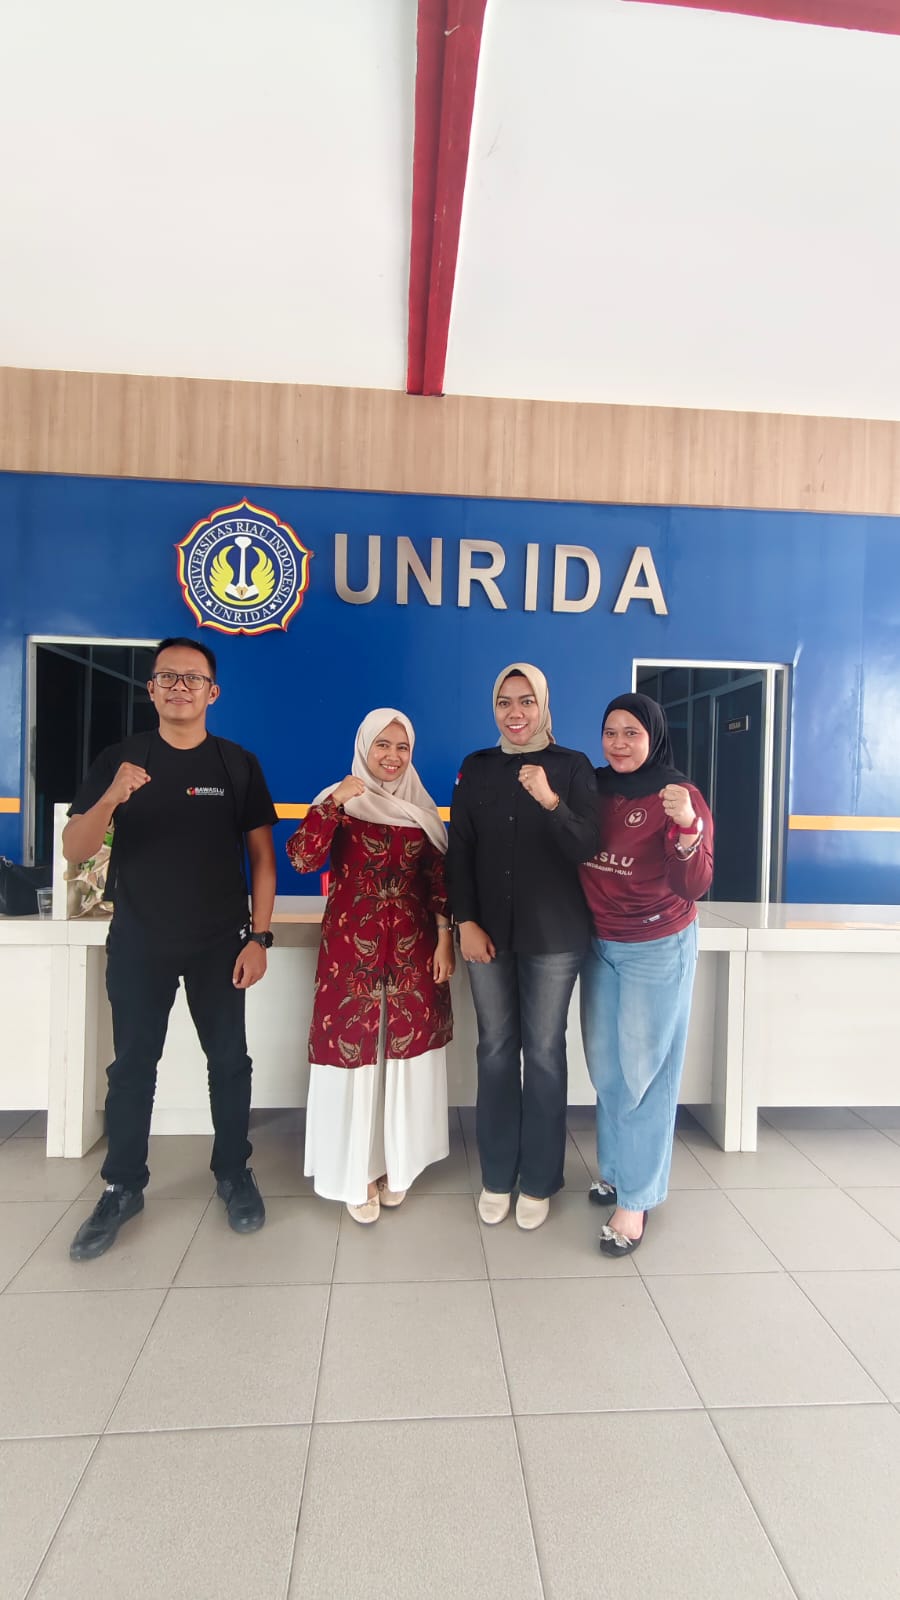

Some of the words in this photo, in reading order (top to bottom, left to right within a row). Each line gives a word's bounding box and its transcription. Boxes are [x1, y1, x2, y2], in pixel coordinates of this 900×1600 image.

[191, 524, 233, 600] UNIVERSITAS
[236, 522, 270, 538] RIAU
[268, 535, 294, 609] INDONESIA
[335, 533, 668, 615] UNRIDA
[212, 604, 271, 622] UNRIDA
